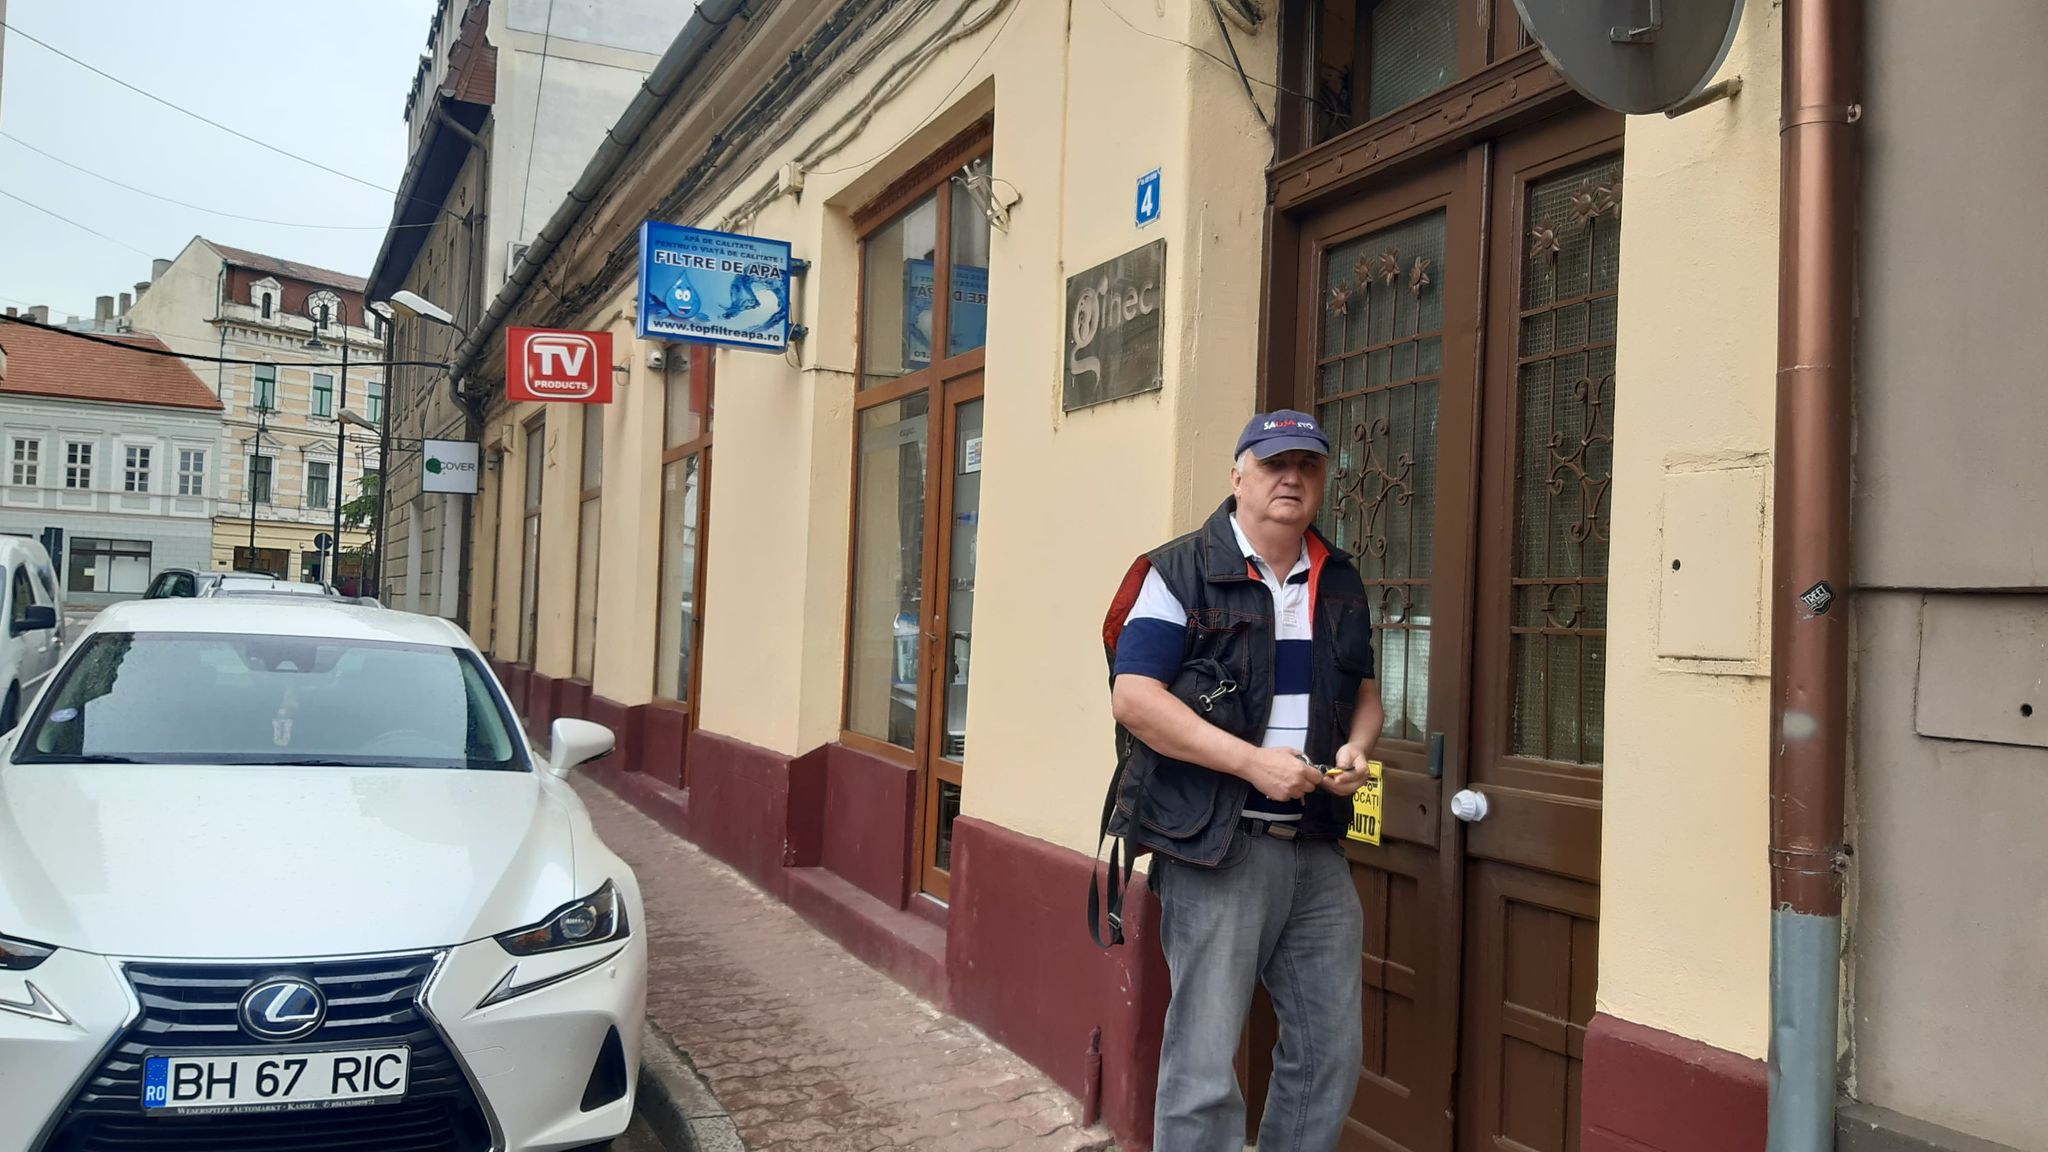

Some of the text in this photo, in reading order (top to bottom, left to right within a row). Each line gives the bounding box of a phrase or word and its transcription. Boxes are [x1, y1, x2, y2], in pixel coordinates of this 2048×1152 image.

[1140, 184, 1153, 216] 4
[655, 240, 689, 251] PENTRU
[740, 252, 778, 263] CALITATE
[655, 251, 781, 279] FILTRE DE APĂ
[653, 320, 780, 342] www.topfiltreapa.ro
[533, 344, 588, 377] TV
[534, 380, 589, 390] PRODUCTS
[1353, 790, 1379, 811] OCAȚI
[1348, 812, 1376, 837] AUTO
[172, 1053, 402, 1101] BH 67 RIC
[146, 1086, 166, 1101] RO
